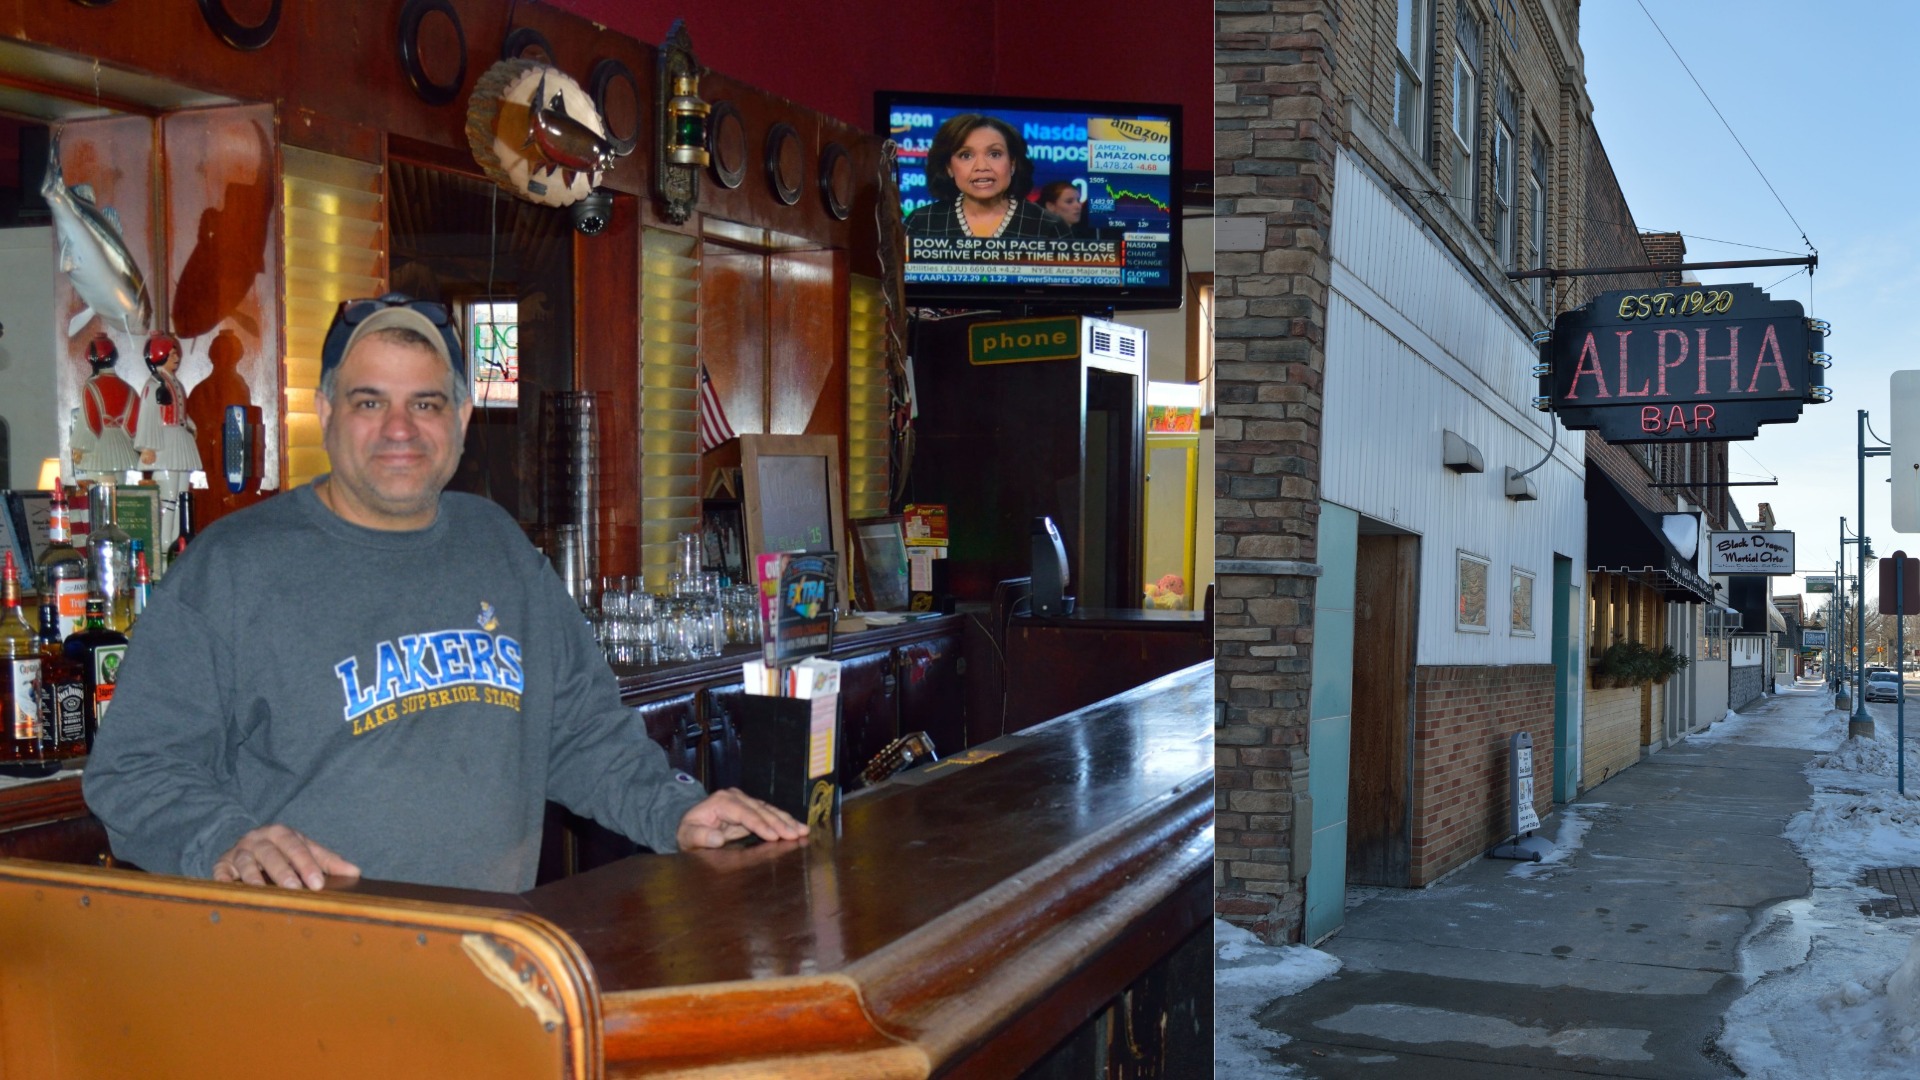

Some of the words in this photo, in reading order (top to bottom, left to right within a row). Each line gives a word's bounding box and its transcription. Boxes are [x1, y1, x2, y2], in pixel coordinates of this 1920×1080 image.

[1110, 118, 1168, 144] amazon
[1094, 143, 1126, 151] (AMZN)
[1094, 161, 1134, 170] 1,478.24
[1136, 163, 1157, 171] -4.68
[913, 238, 952, 250] DOW,
[956, 239, 982, 249] S&P
[985, 240, 1006, 250] ON
[1010, 240, 1046, 251] PACE
[1049, 241, 1068, 252] TO
[1071, 242, 1115, 253] CLOSE
[913, 249, 970, 260] POSITIVE
[973, 251, 1000, 260] FOR
[1003, 251, 1022, 261] 1ST
[1025, 251, 1054, 261] TIME
[1057, 252, 1070, 262] IN
[1073, 253, 1080, 262] 3
[1083, 253, 1116, 263] DAYS
[906, 264, 938, 272] Utilities
[1076, 268, 1099, 276] Major
[920, 274, 951, 282] (AAPL)
[1617, 291, 1675, 320] EST.
[1679, 290, 1734, 316] 1920
[982, 331, 1067, 352] phone
[1564, 324, 1796, 399] ALPHA
[1641, 404, 1715, 433] BAR
[1716, 538, 1749, 552] Black
[1751, 535, 1789, 553] Dragon
[1721, 552, 1759, 563] Martial
[1760, 552, 1784, 563] Arts
[787, 577, 825, 609] EXTRA
[334, 629, 524, 721] LAKERS
[352, 703, 398, 735] LAKE
[401, 685, 480, 714] SUPERIOR
[484, 687, 520, 712] STATE
